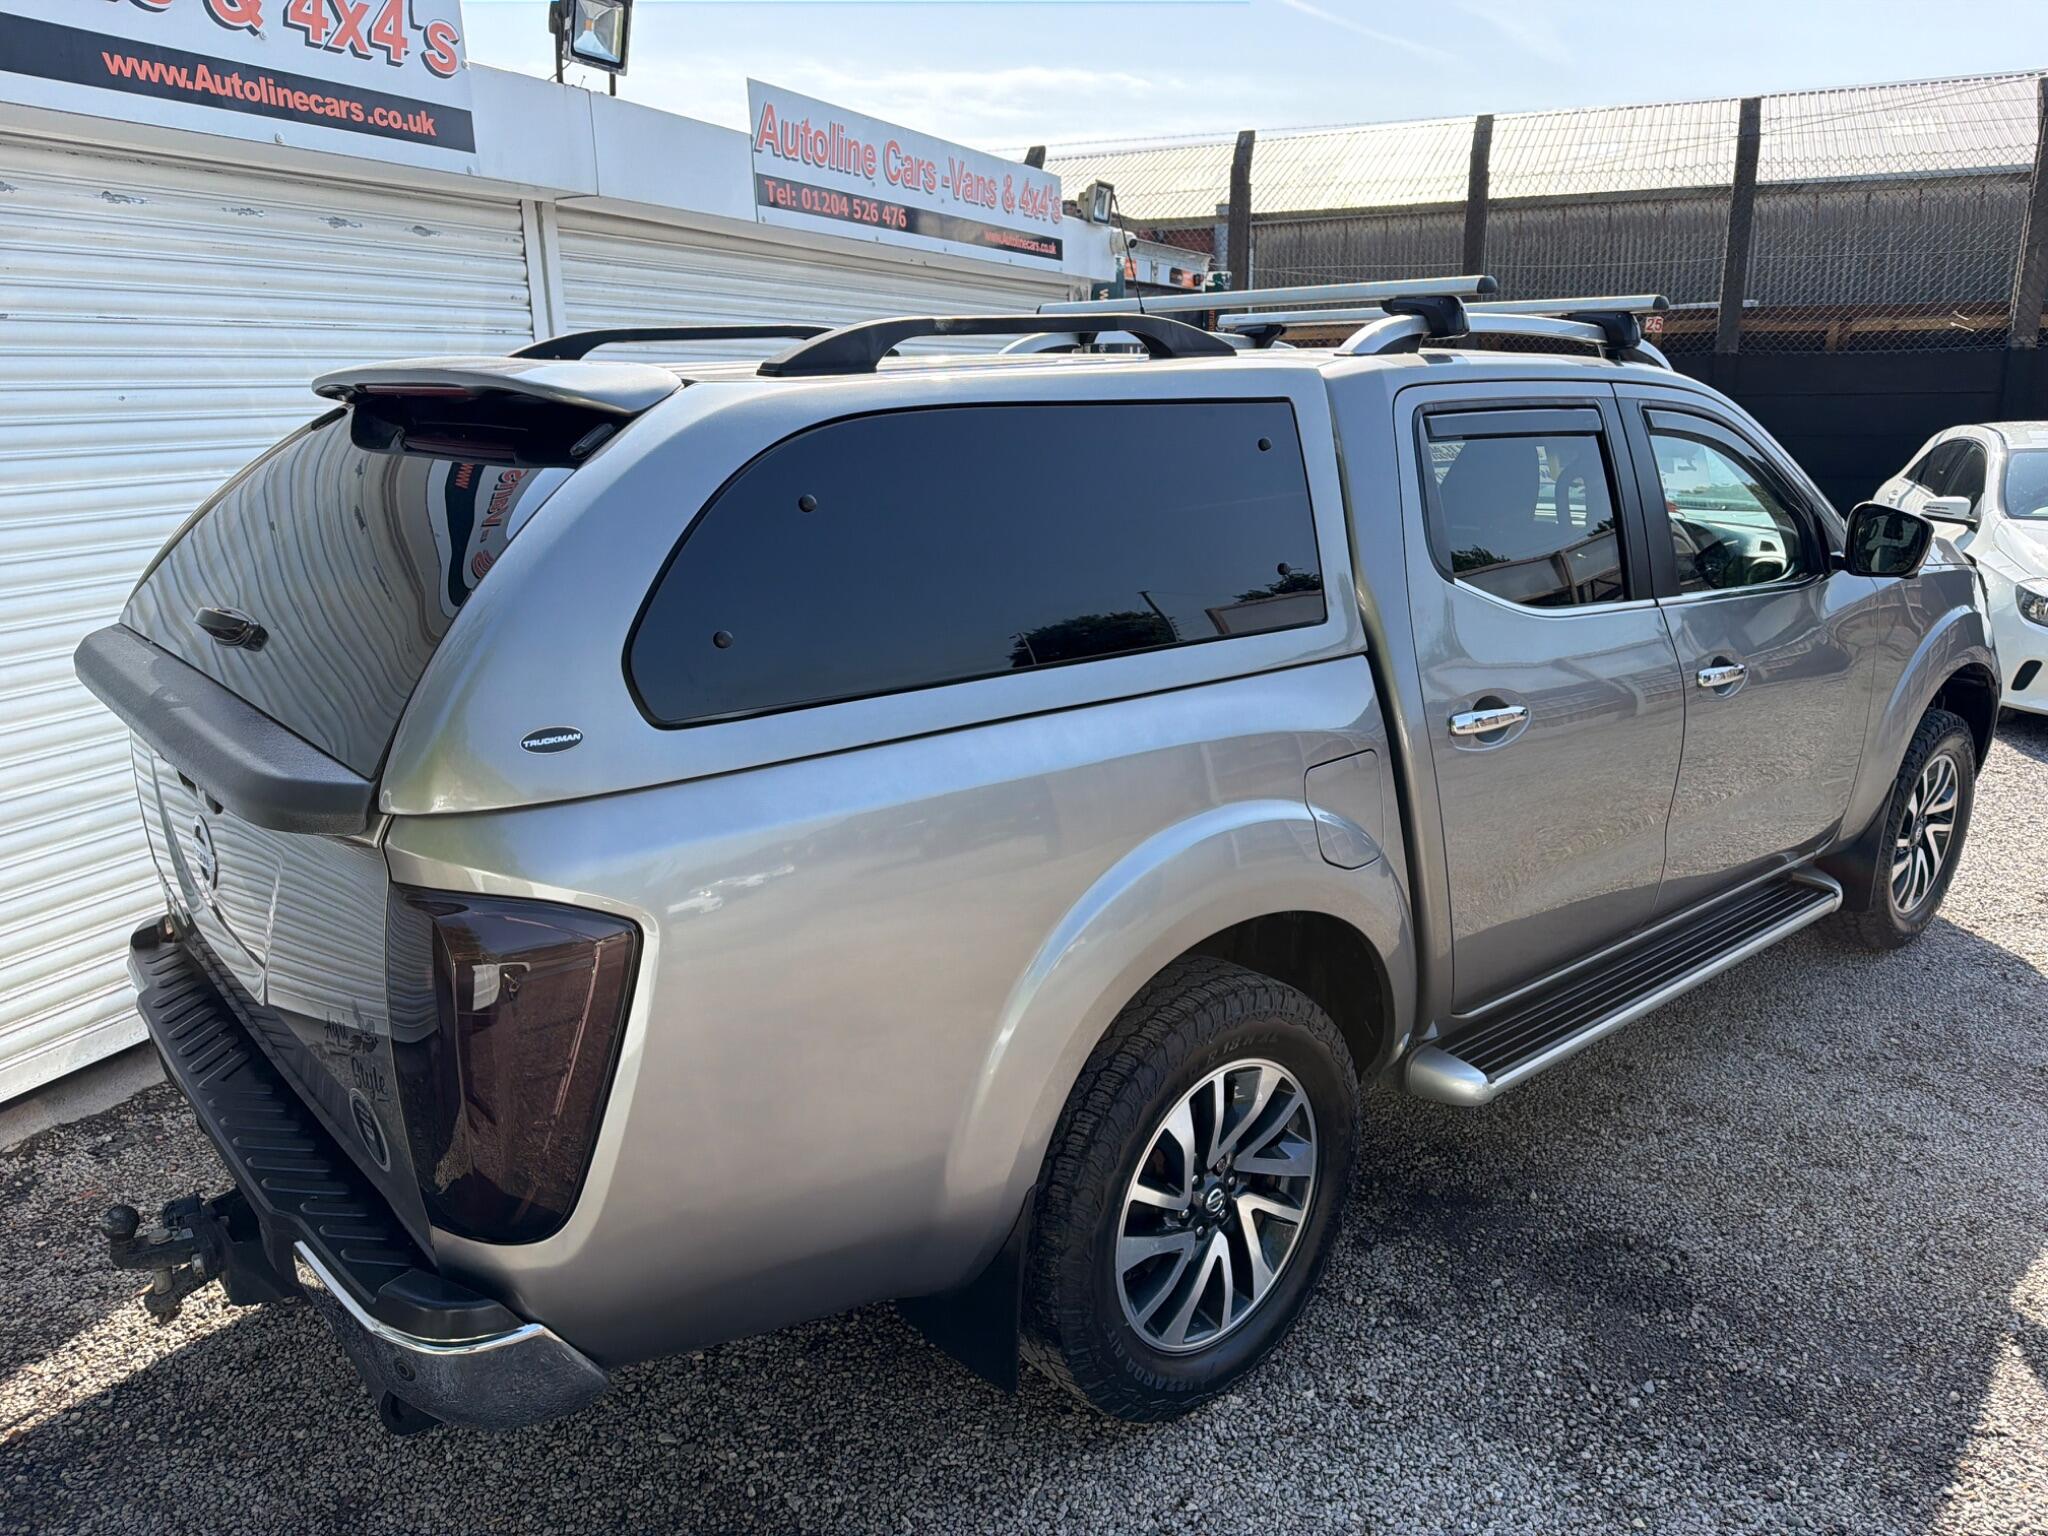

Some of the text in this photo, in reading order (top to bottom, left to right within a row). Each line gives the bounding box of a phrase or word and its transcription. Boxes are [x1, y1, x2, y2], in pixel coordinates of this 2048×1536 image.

[102, 52, 436, 137] www.Autolinecars.co.uk
[754, 101, 877, 178] Autoline
[883, 138, 937, 194] Cars
[1002, 173, 1016, 215] &
[1019, 178, 1062, 224] 4x4's
[764, 178, 907, 229] Tel: 01204 526 476
[523, 733, 580, 748] TRUCKMAN
